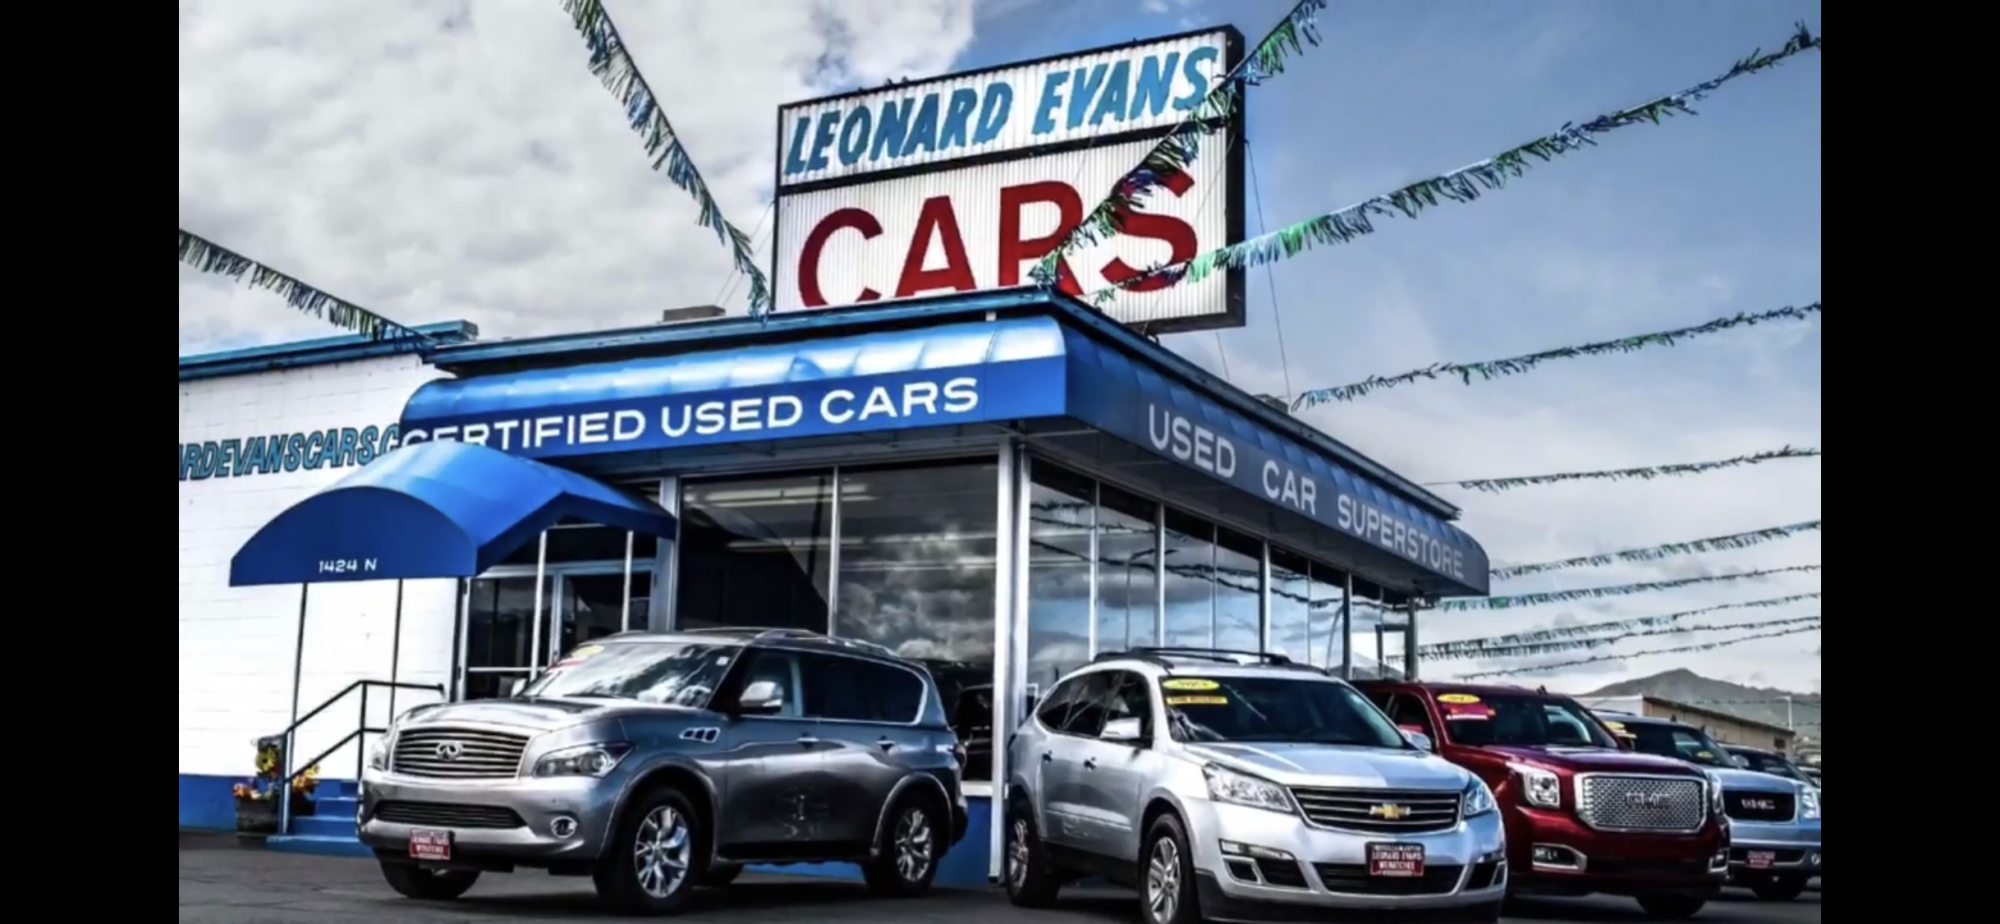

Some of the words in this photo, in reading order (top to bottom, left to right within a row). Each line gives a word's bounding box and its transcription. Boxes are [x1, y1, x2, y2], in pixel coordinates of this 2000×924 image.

[784, 81, 1014, 175] LEONARD
[1031, 46, 1218, 135] EVANS
[797, 169, 1198, 308] CARS
[661, 395, 803, 438] USED
[820, 377, 979, 424] CARS
[1149, 403, 1236, 479] USED
[1262, 459, 1317, 516] CAR
[1337, 493, 1464, 581] SUPERSTORE
[319, 559, 358, 574] 1424
[364, 558, 379, 572] N
